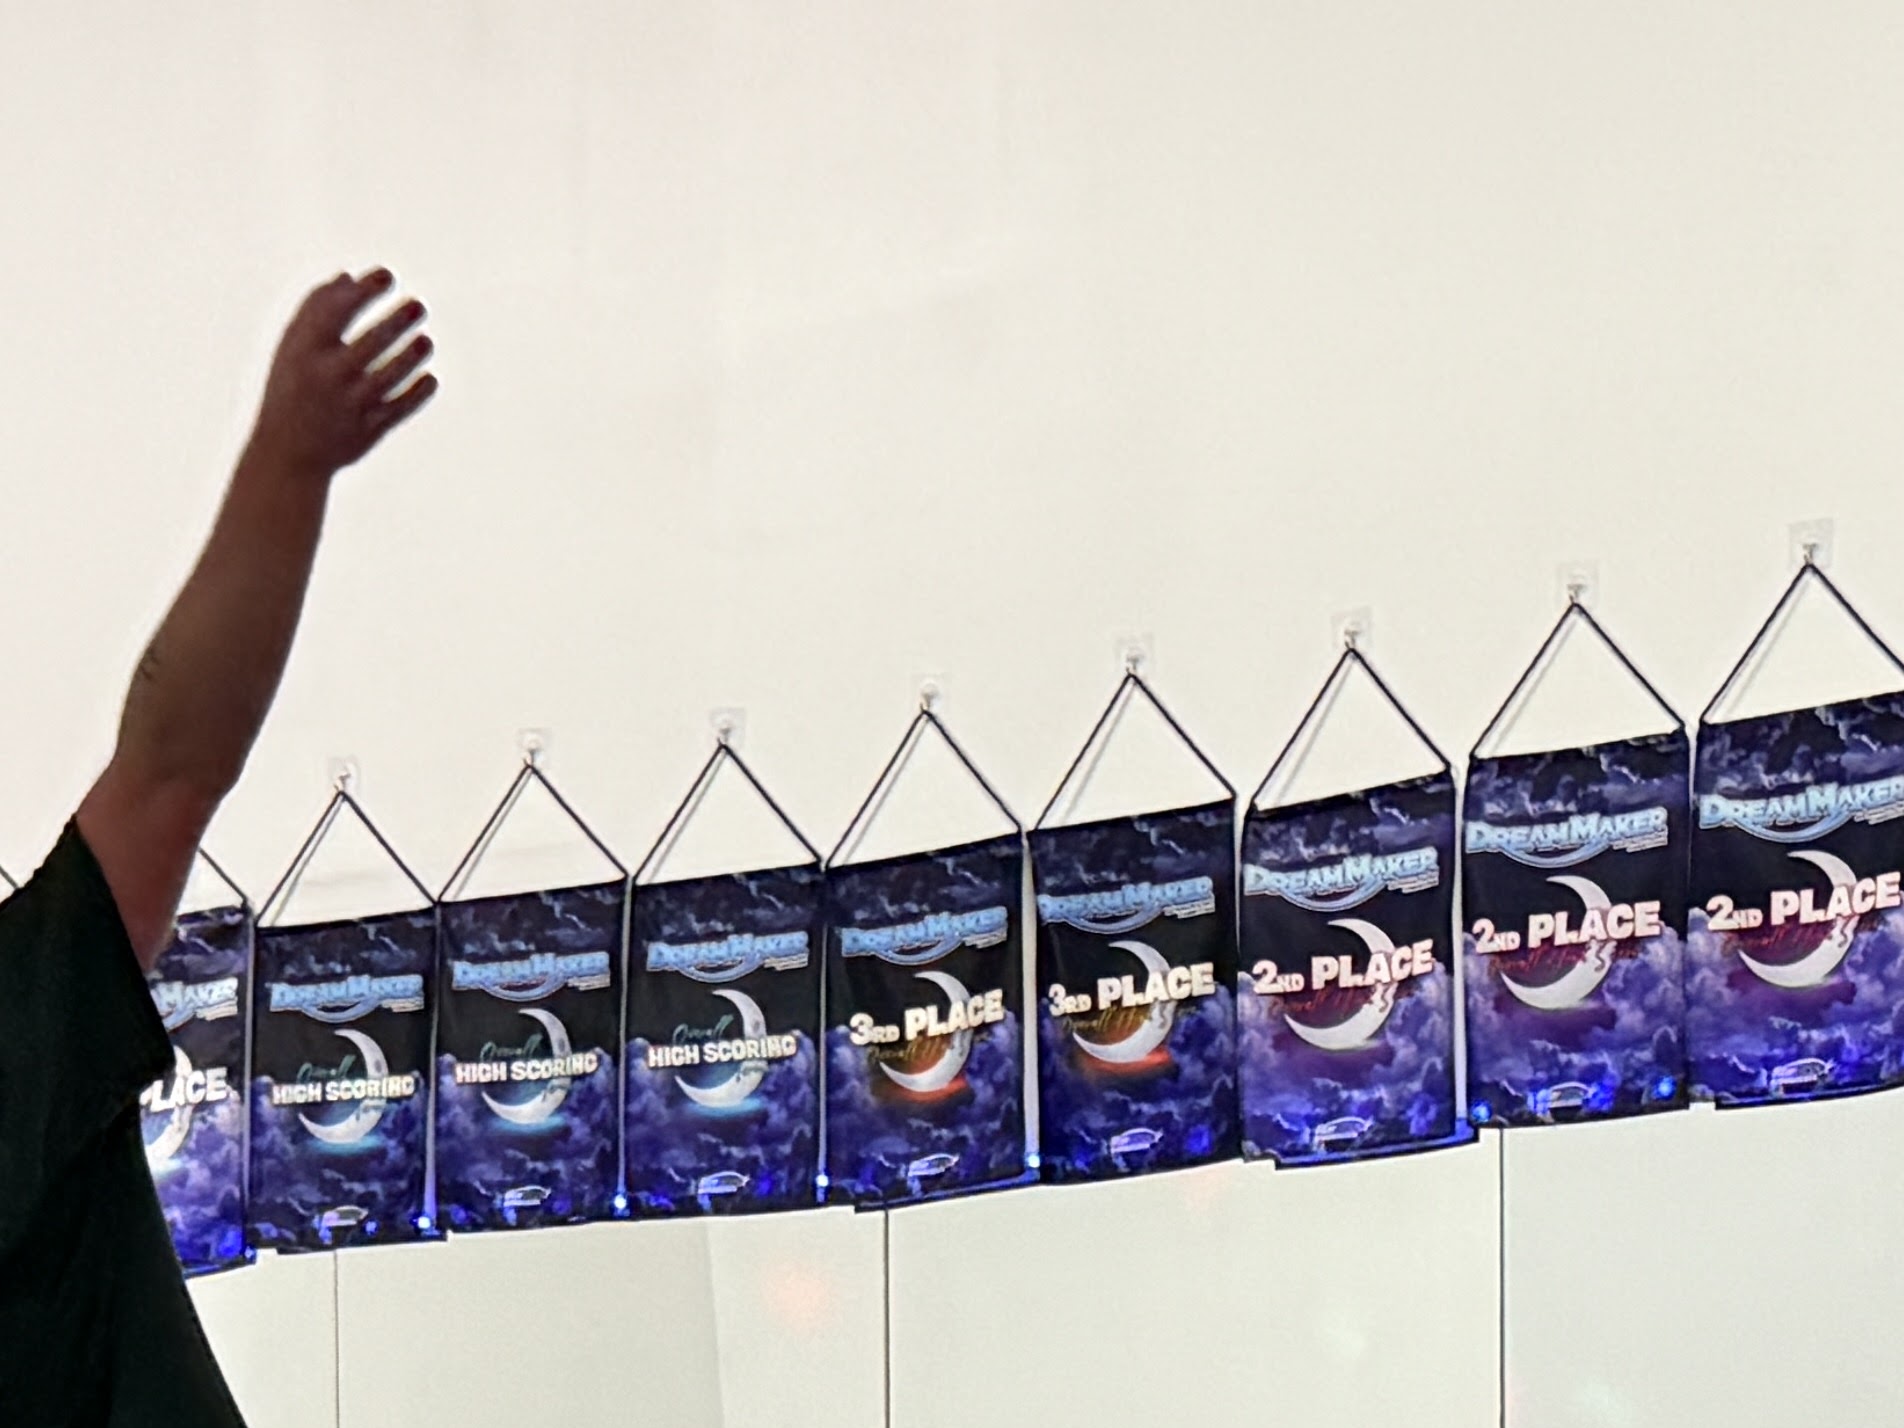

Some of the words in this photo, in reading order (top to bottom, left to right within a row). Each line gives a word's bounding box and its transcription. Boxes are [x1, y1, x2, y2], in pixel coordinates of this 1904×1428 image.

[1472, 918, 1521, 954] 2ND
[1528, 900, 1661, 949] PLACE
[1706, 894, 1763, 932] 2ND
[1770, 871, 1902, 926] PLACE
[1049, 983, 1092, 1017] 3RD
[1098, 962, 1217, 1010] PLACE
[1253, 960, 1305, 996] 2ND
[1311, 939, 1435, 992] PLACE
[850, 1012, 901, 1046] 3RD
[904, 988, 1005, 1041] PLACE
[455, 1060, 507, 1085] HIGH
[510, 1052, 599, 1081] SCORING
[649, 1043, 701, 1069] HIGH
[703, 1034, 798, 1062] SCORING
[272, 1080, 323, 1105] HIGH
[325, 1074, 417, 1102] SCORING
